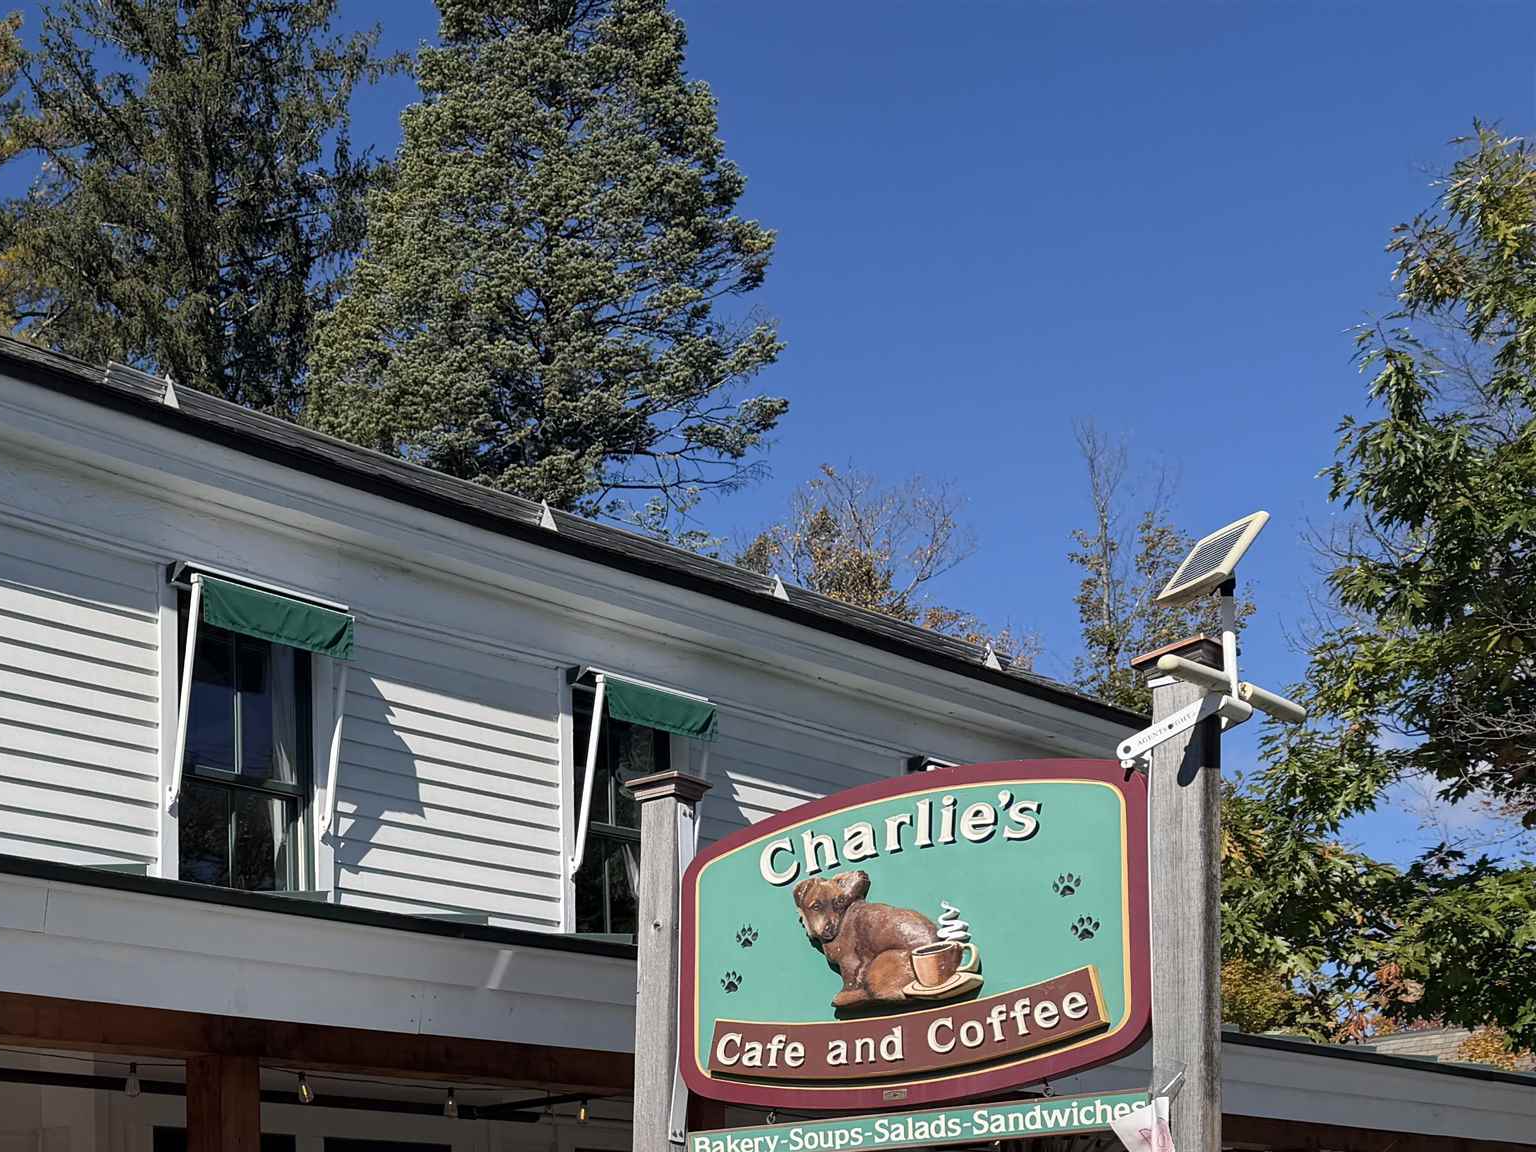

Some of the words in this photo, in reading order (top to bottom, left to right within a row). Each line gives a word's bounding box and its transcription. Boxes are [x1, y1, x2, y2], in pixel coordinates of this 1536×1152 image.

[759, 790, 1042, 885] Charlie's
[716, 1032, 806, 1068] Cafe
[826, 1027, 905, 1066] and
[927, 988, 1089, 1054] Coffee
